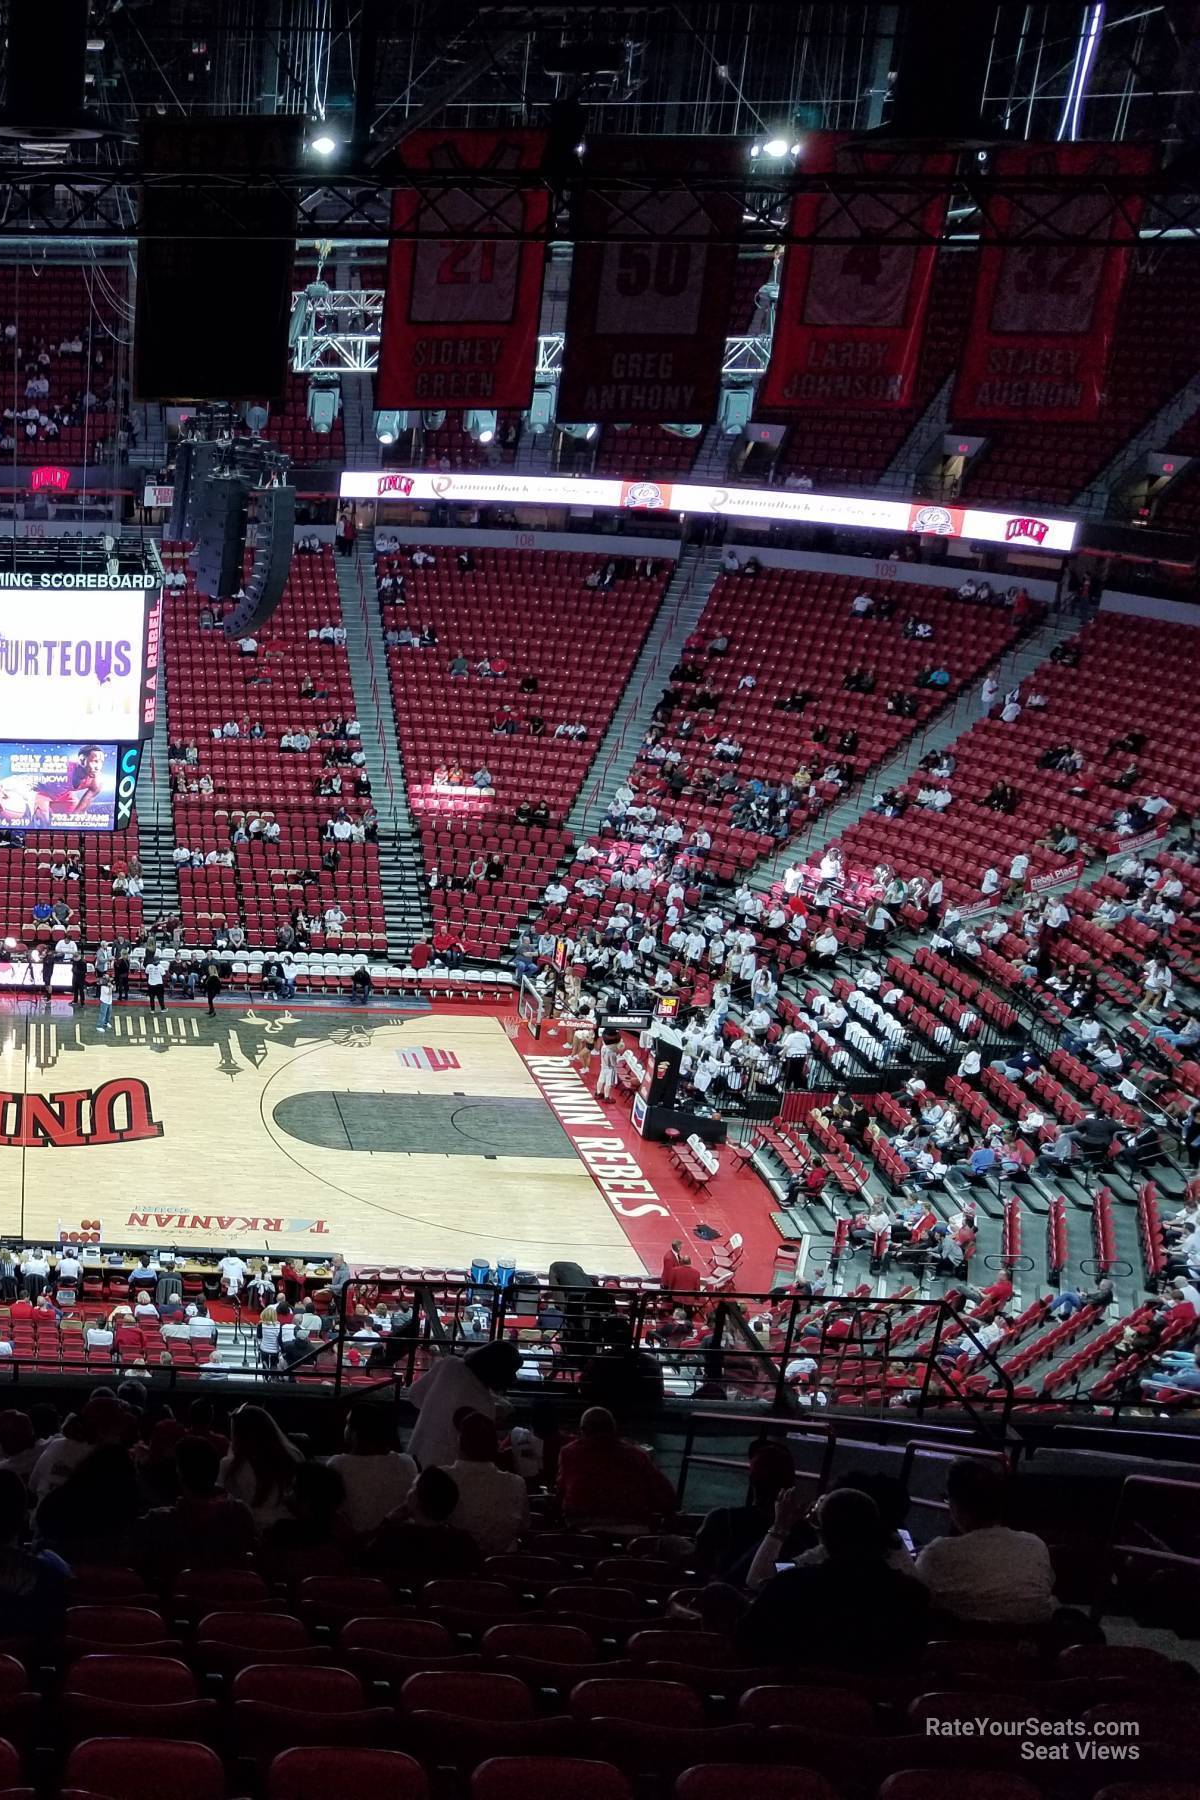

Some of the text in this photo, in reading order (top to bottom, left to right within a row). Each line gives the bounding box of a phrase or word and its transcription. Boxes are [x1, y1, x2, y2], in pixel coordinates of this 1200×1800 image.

[436, 224, 498, 285] 21
[615, 238, 692, 298] 50
[414, 340, 502, 367] SIDNEY
[611, 352, 674, 380] GREG
[807, 341, 888, 368] LARRY
[987, 349, 1082, 375] STACEY
[416, 371, 496, 398] GREEN
[783, 375, 902, 401] JOHNSON
[976, 381, 1083, 409] AUGMON
[584, 384, 698, 413] ANTHONY
[31, 465, 71, 491] UNLV
[377, 474, 416, 496] UNLV
[23, 524, 45, 537] 106
[513, 533, 535, 547] 108
[1004, 517, 1049, 545] UNLV
[39, 573, 156, 588] SCOREBOARD
[873, 562, 898, 577] 109
[117, 749, 138, 820] COX
[11, 818, 31, 826] 2019
[1030, 865, 1079, 888] Rebel Place
[607, 1016, 642, 1024] NISSAN
[572, 1135, 671, 1217] REBELS
